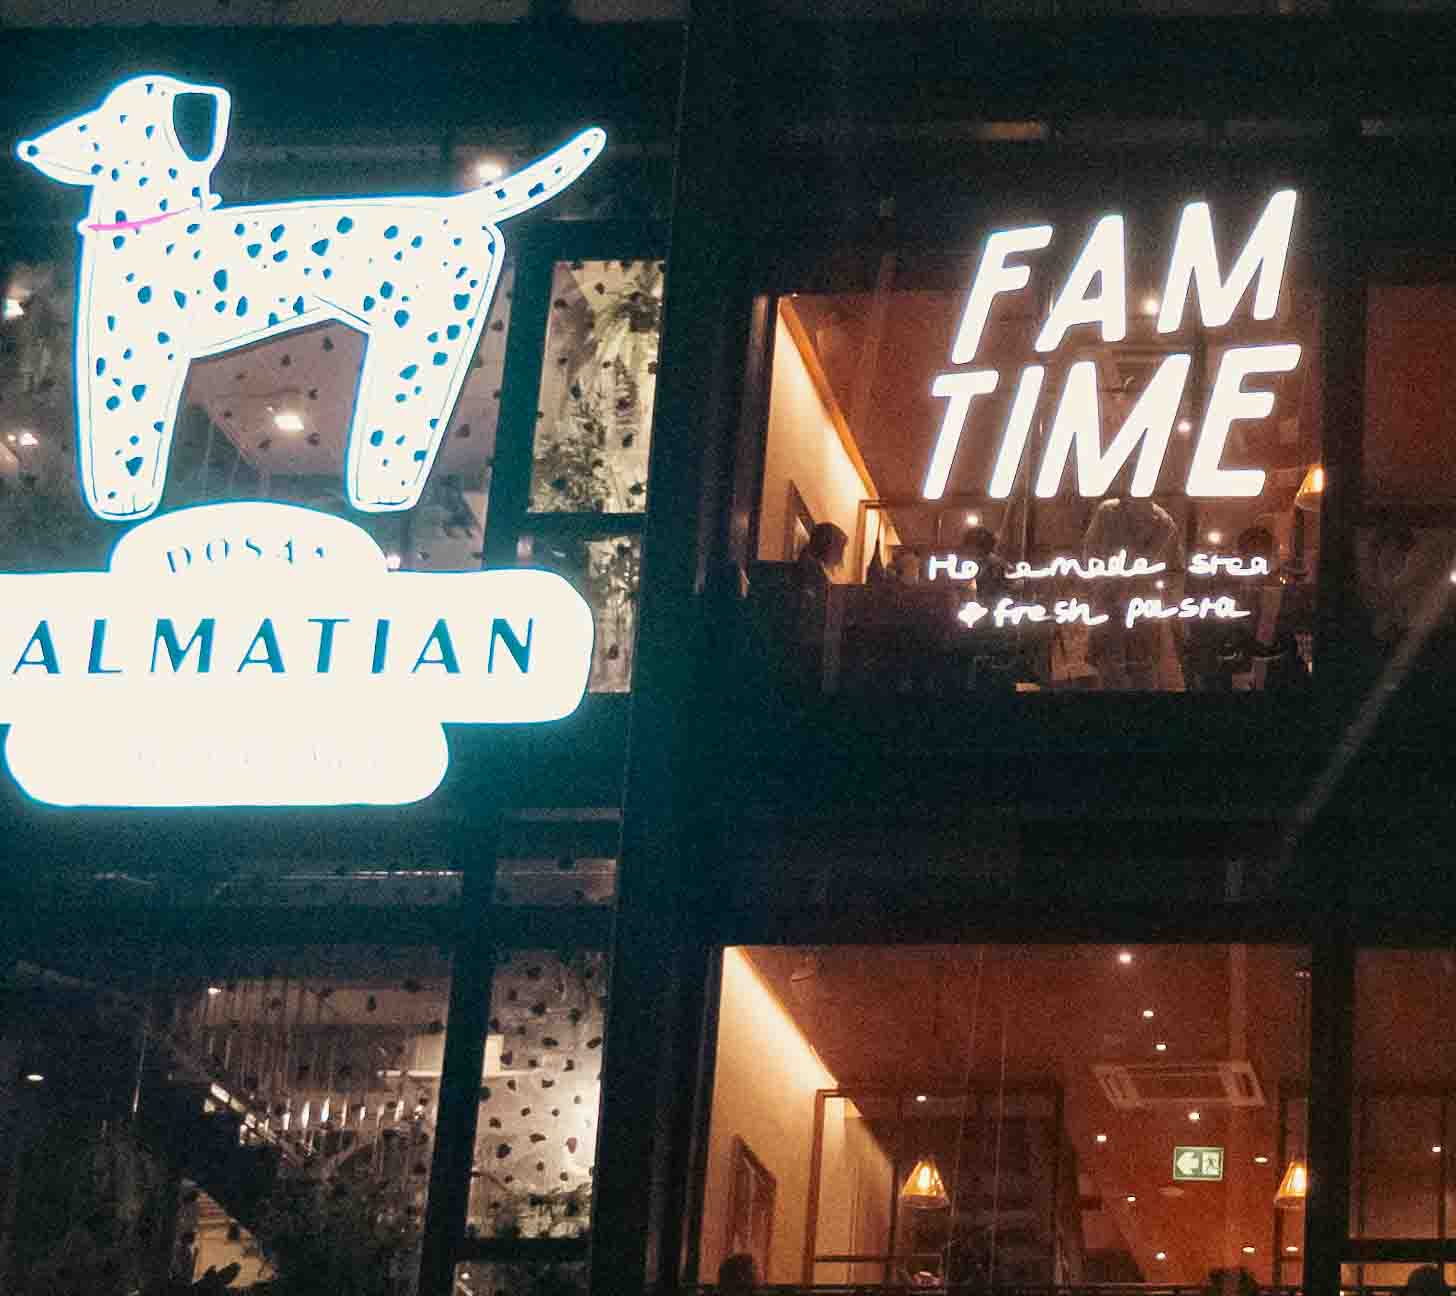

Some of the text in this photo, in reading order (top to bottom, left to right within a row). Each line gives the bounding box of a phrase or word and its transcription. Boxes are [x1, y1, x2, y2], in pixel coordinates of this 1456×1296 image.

[950, 190, 1297, 364] FAM
[922, 344, 1302, 500] TIME
[993, 598, 1109, 628] fresh
[1125, 597, 1251, 629] pasta
